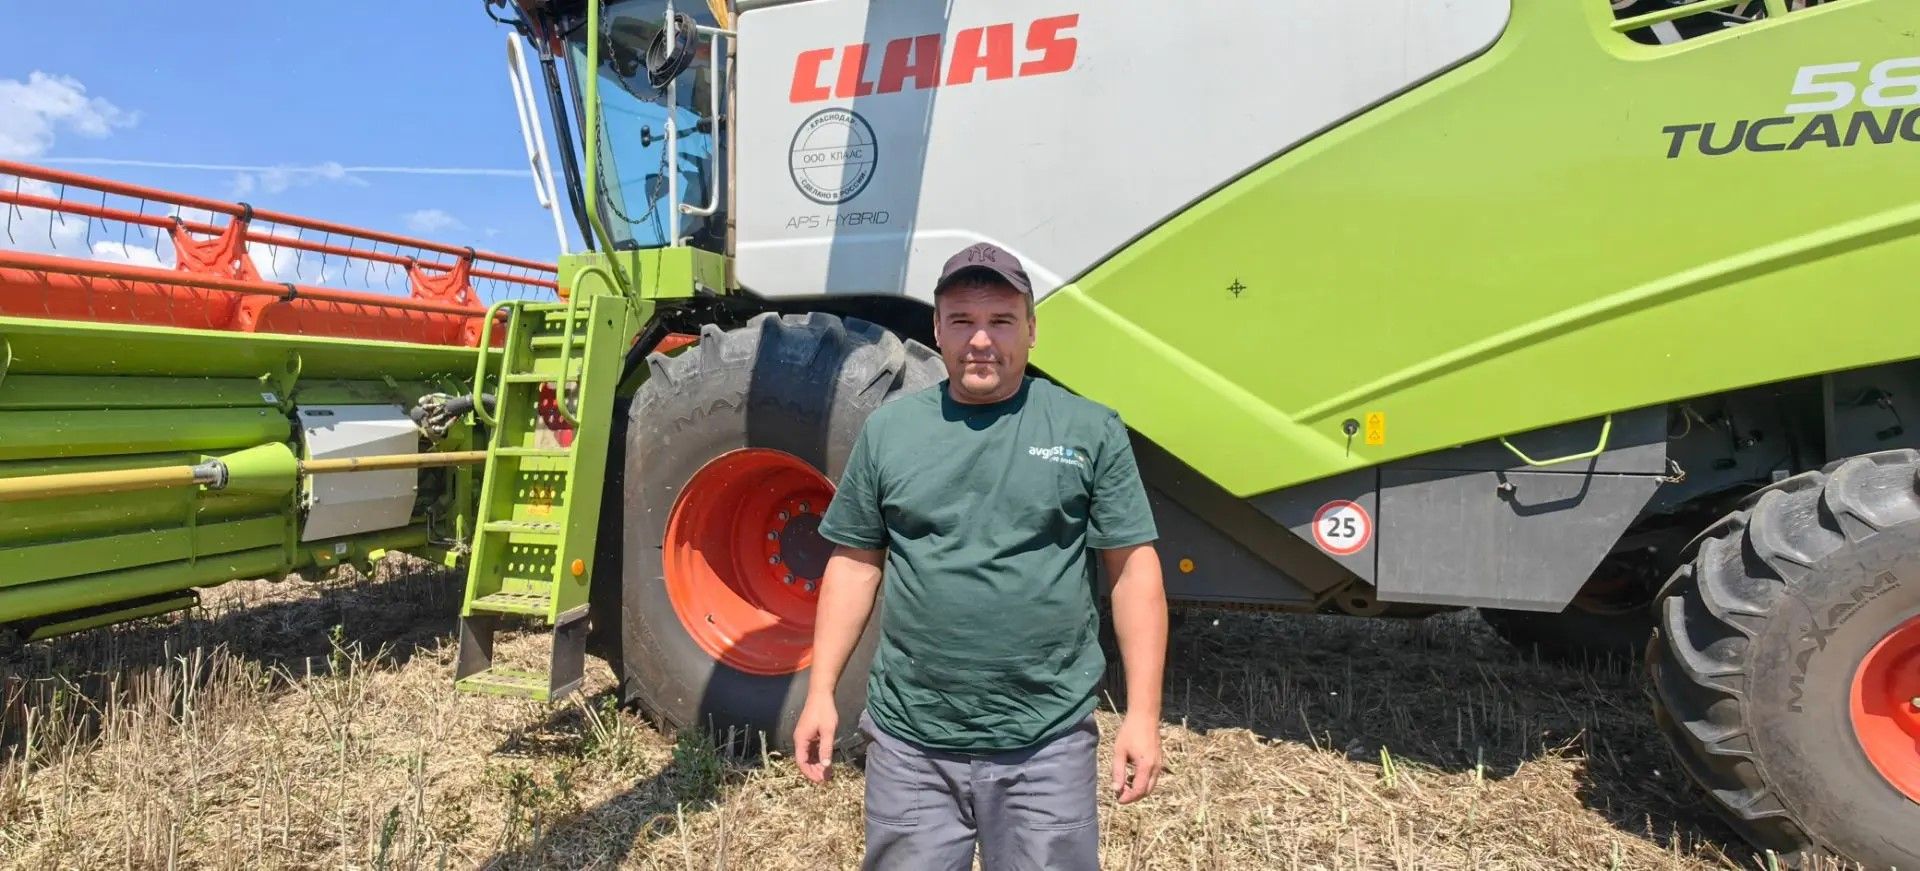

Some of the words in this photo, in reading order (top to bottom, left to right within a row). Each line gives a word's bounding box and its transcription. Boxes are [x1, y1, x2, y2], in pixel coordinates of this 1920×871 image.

[789, 13, 1079, 103] CLAAS
[810, 113, 857, 128] КРАСНОДАР
[803, 153, 825, 163] ООО
[830, 150, 863, 161] КЛААС
[801, 178, 832, 199] СДЕЛАНО
[839, 172, 866, 197] РОССИИ
[785, 215, 820, 229] APS
[825, 210, 889, 227] HYBRID
[1326, 517, 1356, 538] 25
